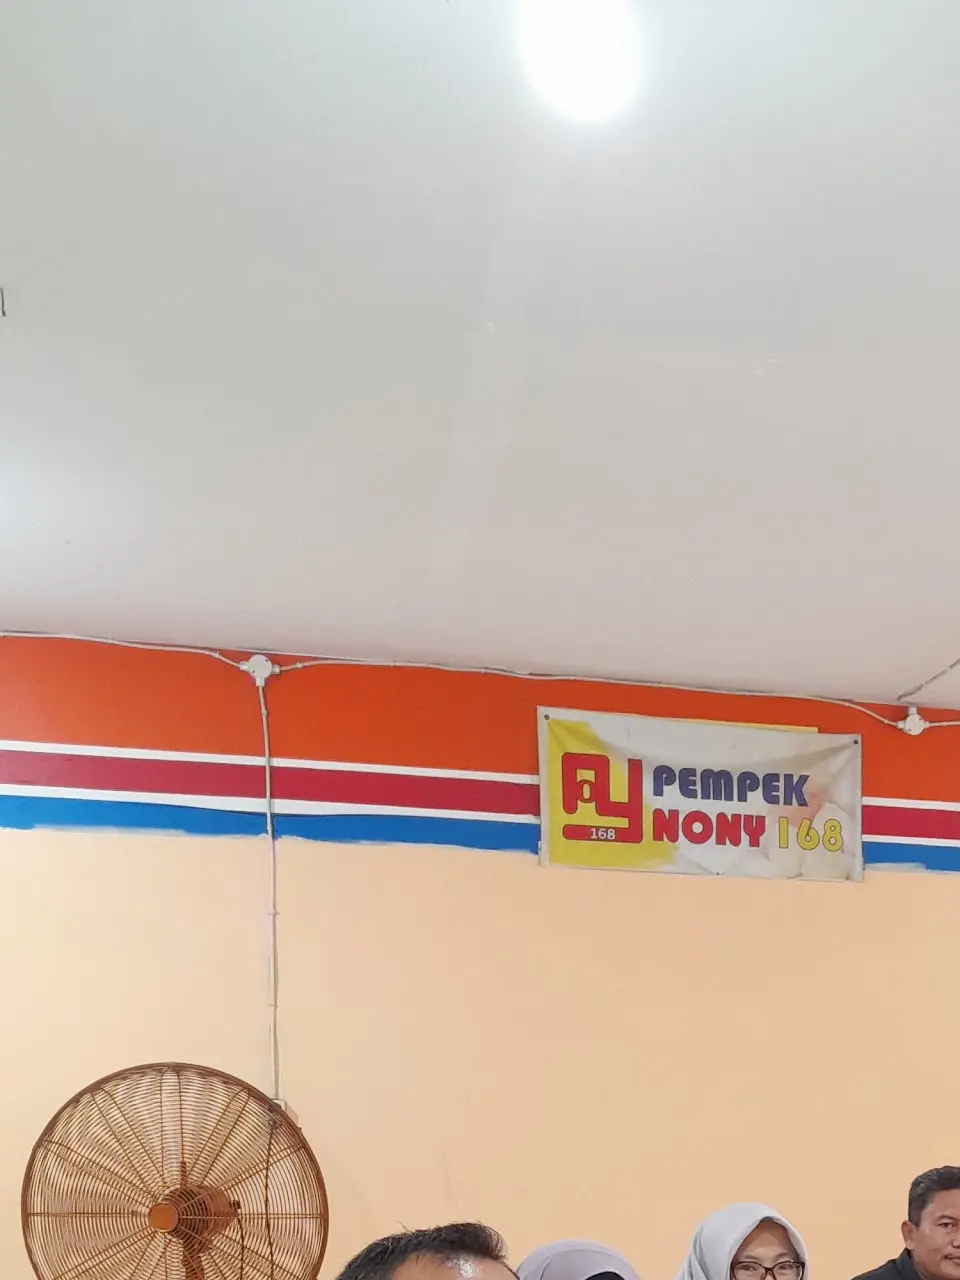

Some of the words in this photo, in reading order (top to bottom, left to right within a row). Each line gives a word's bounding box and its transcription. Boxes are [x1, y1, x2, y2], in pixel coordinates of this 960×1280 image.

[653, 765, 810, 807] PEMPEK
[590, 828, 616, 840] 168
[652, 808, 766, 848] NONY
[778, 816, 844, 852] 168
